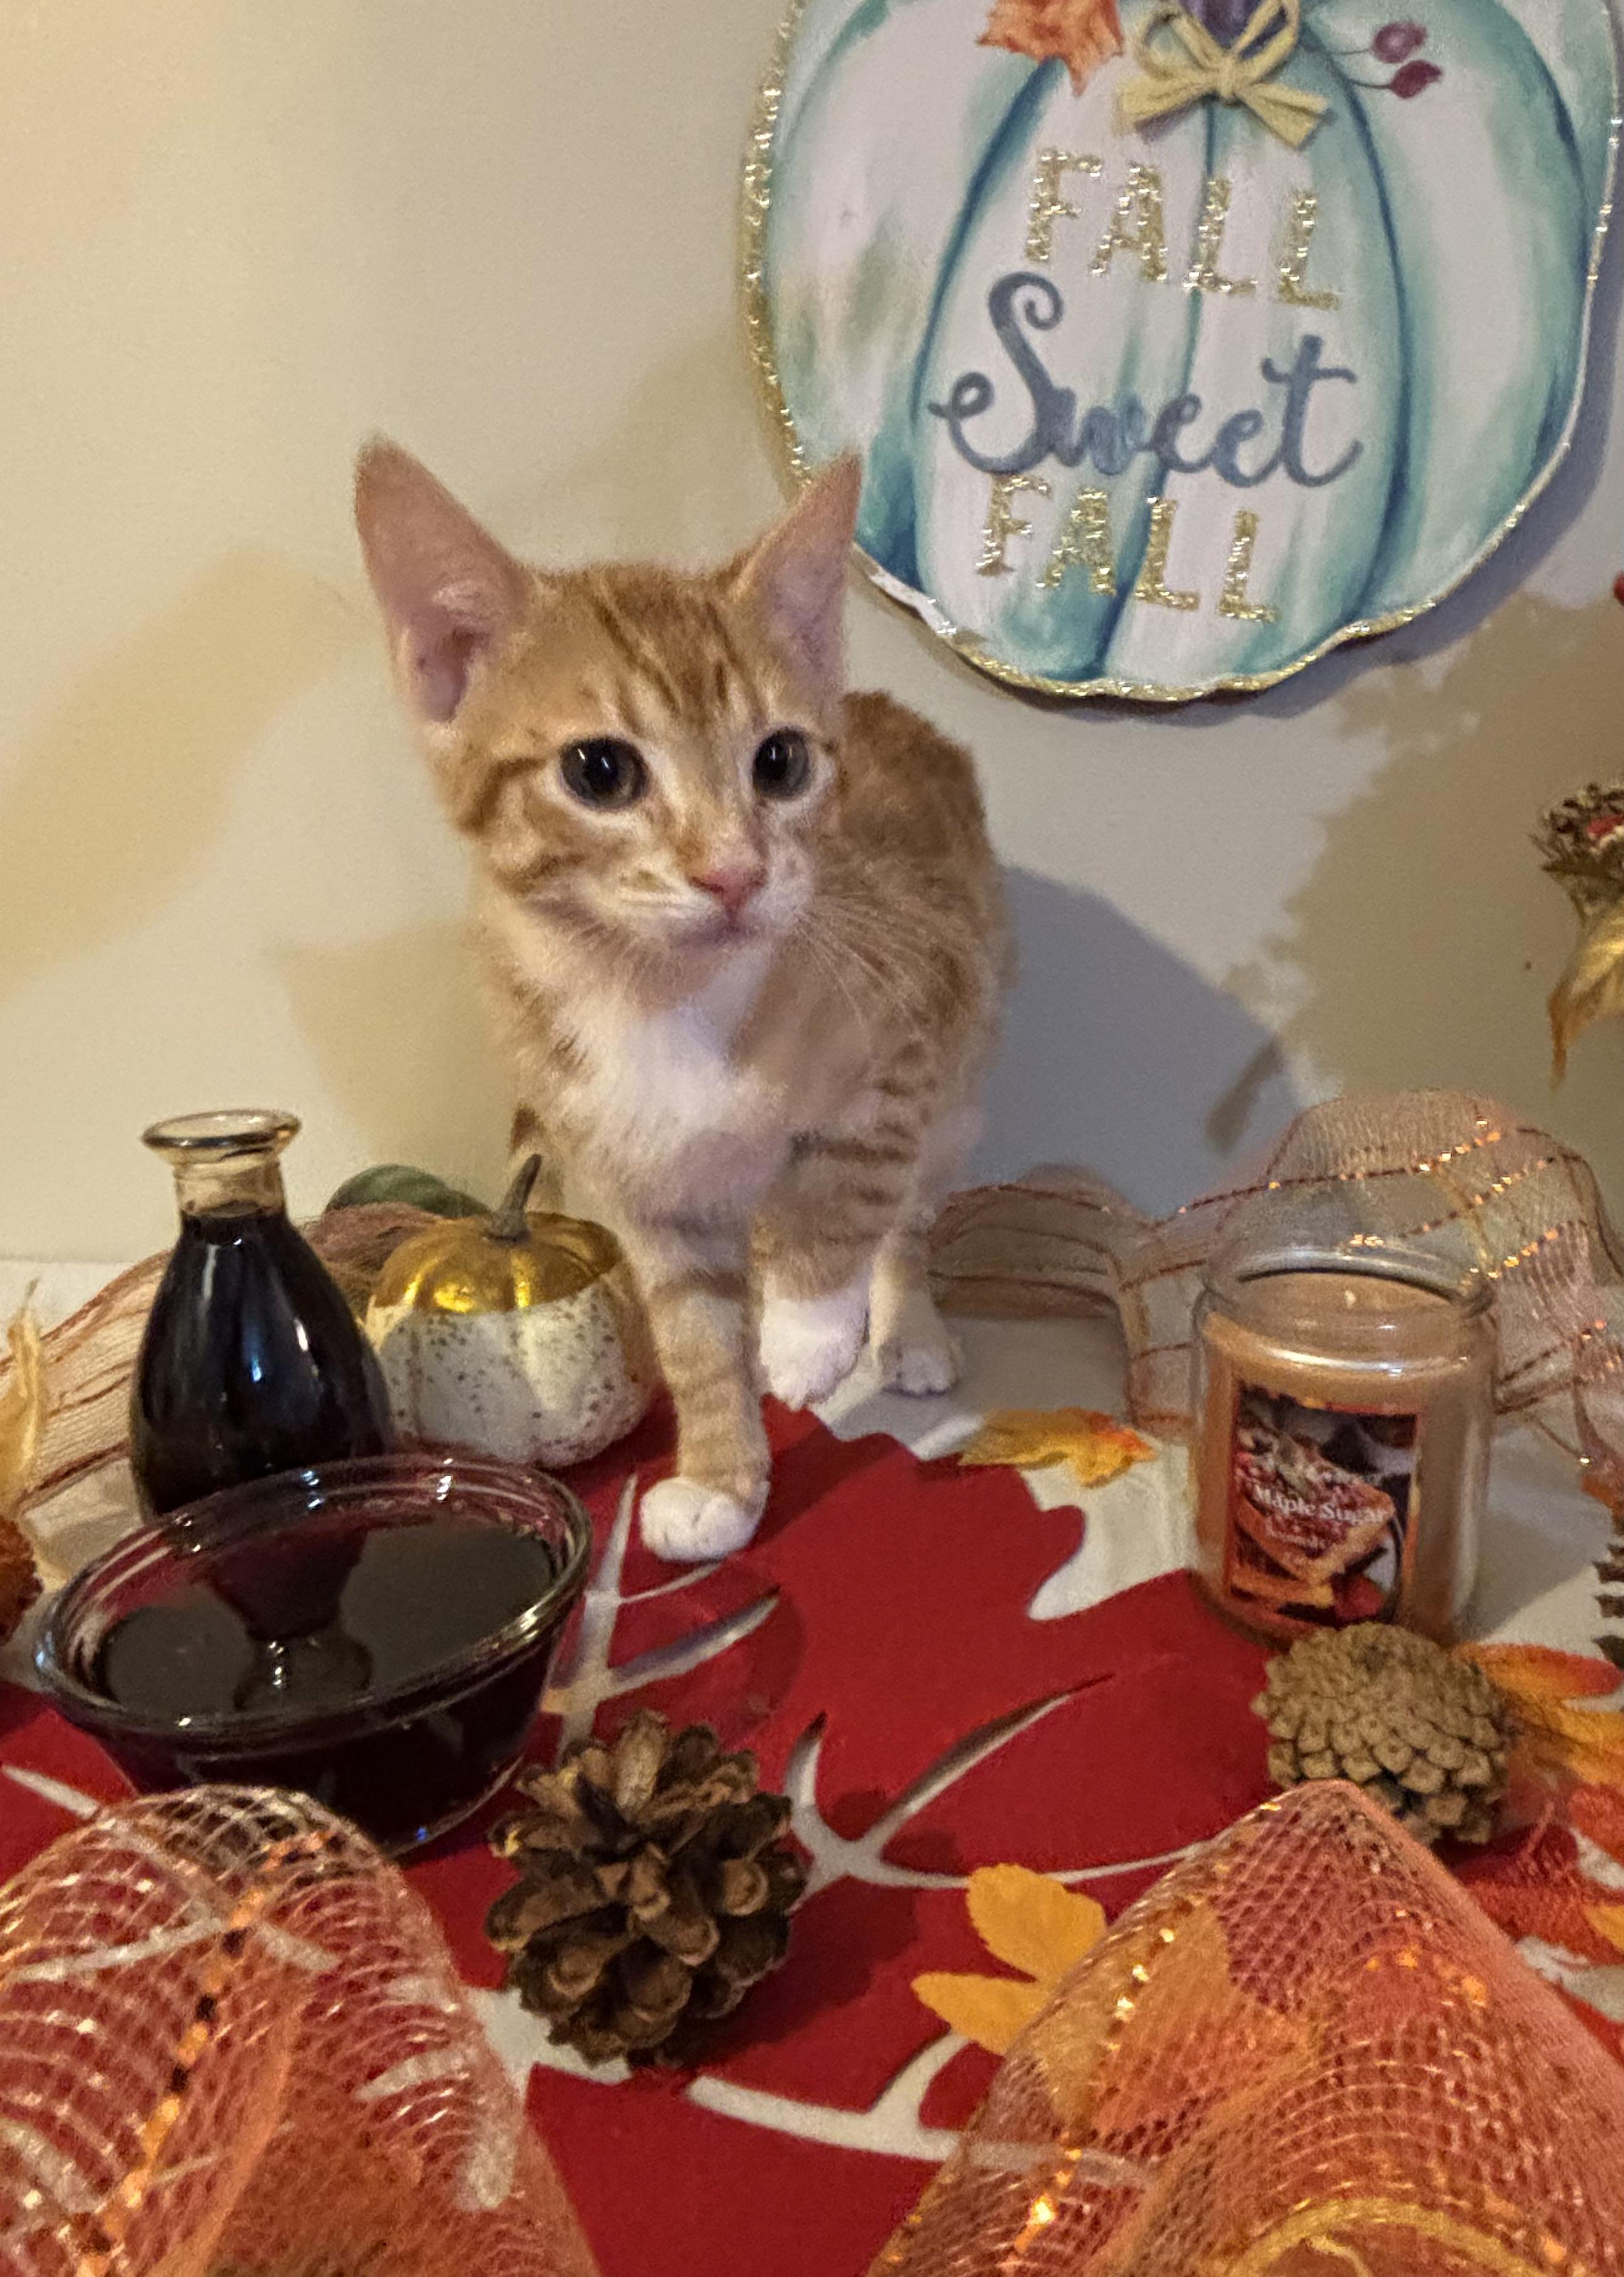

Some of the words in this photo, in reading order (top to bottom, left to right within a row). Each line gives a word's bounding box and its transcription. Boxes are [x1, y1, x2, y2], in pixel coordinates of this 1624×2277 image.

[1025, 149, 1340, 310] FALL
[929, 271, 1364, 488] Sweet
[975, 475, 1276, 622] FALL
[1254, 1484, 1316, 1516] Maple
[1320, 1503, 1389, 1527] Sugar
